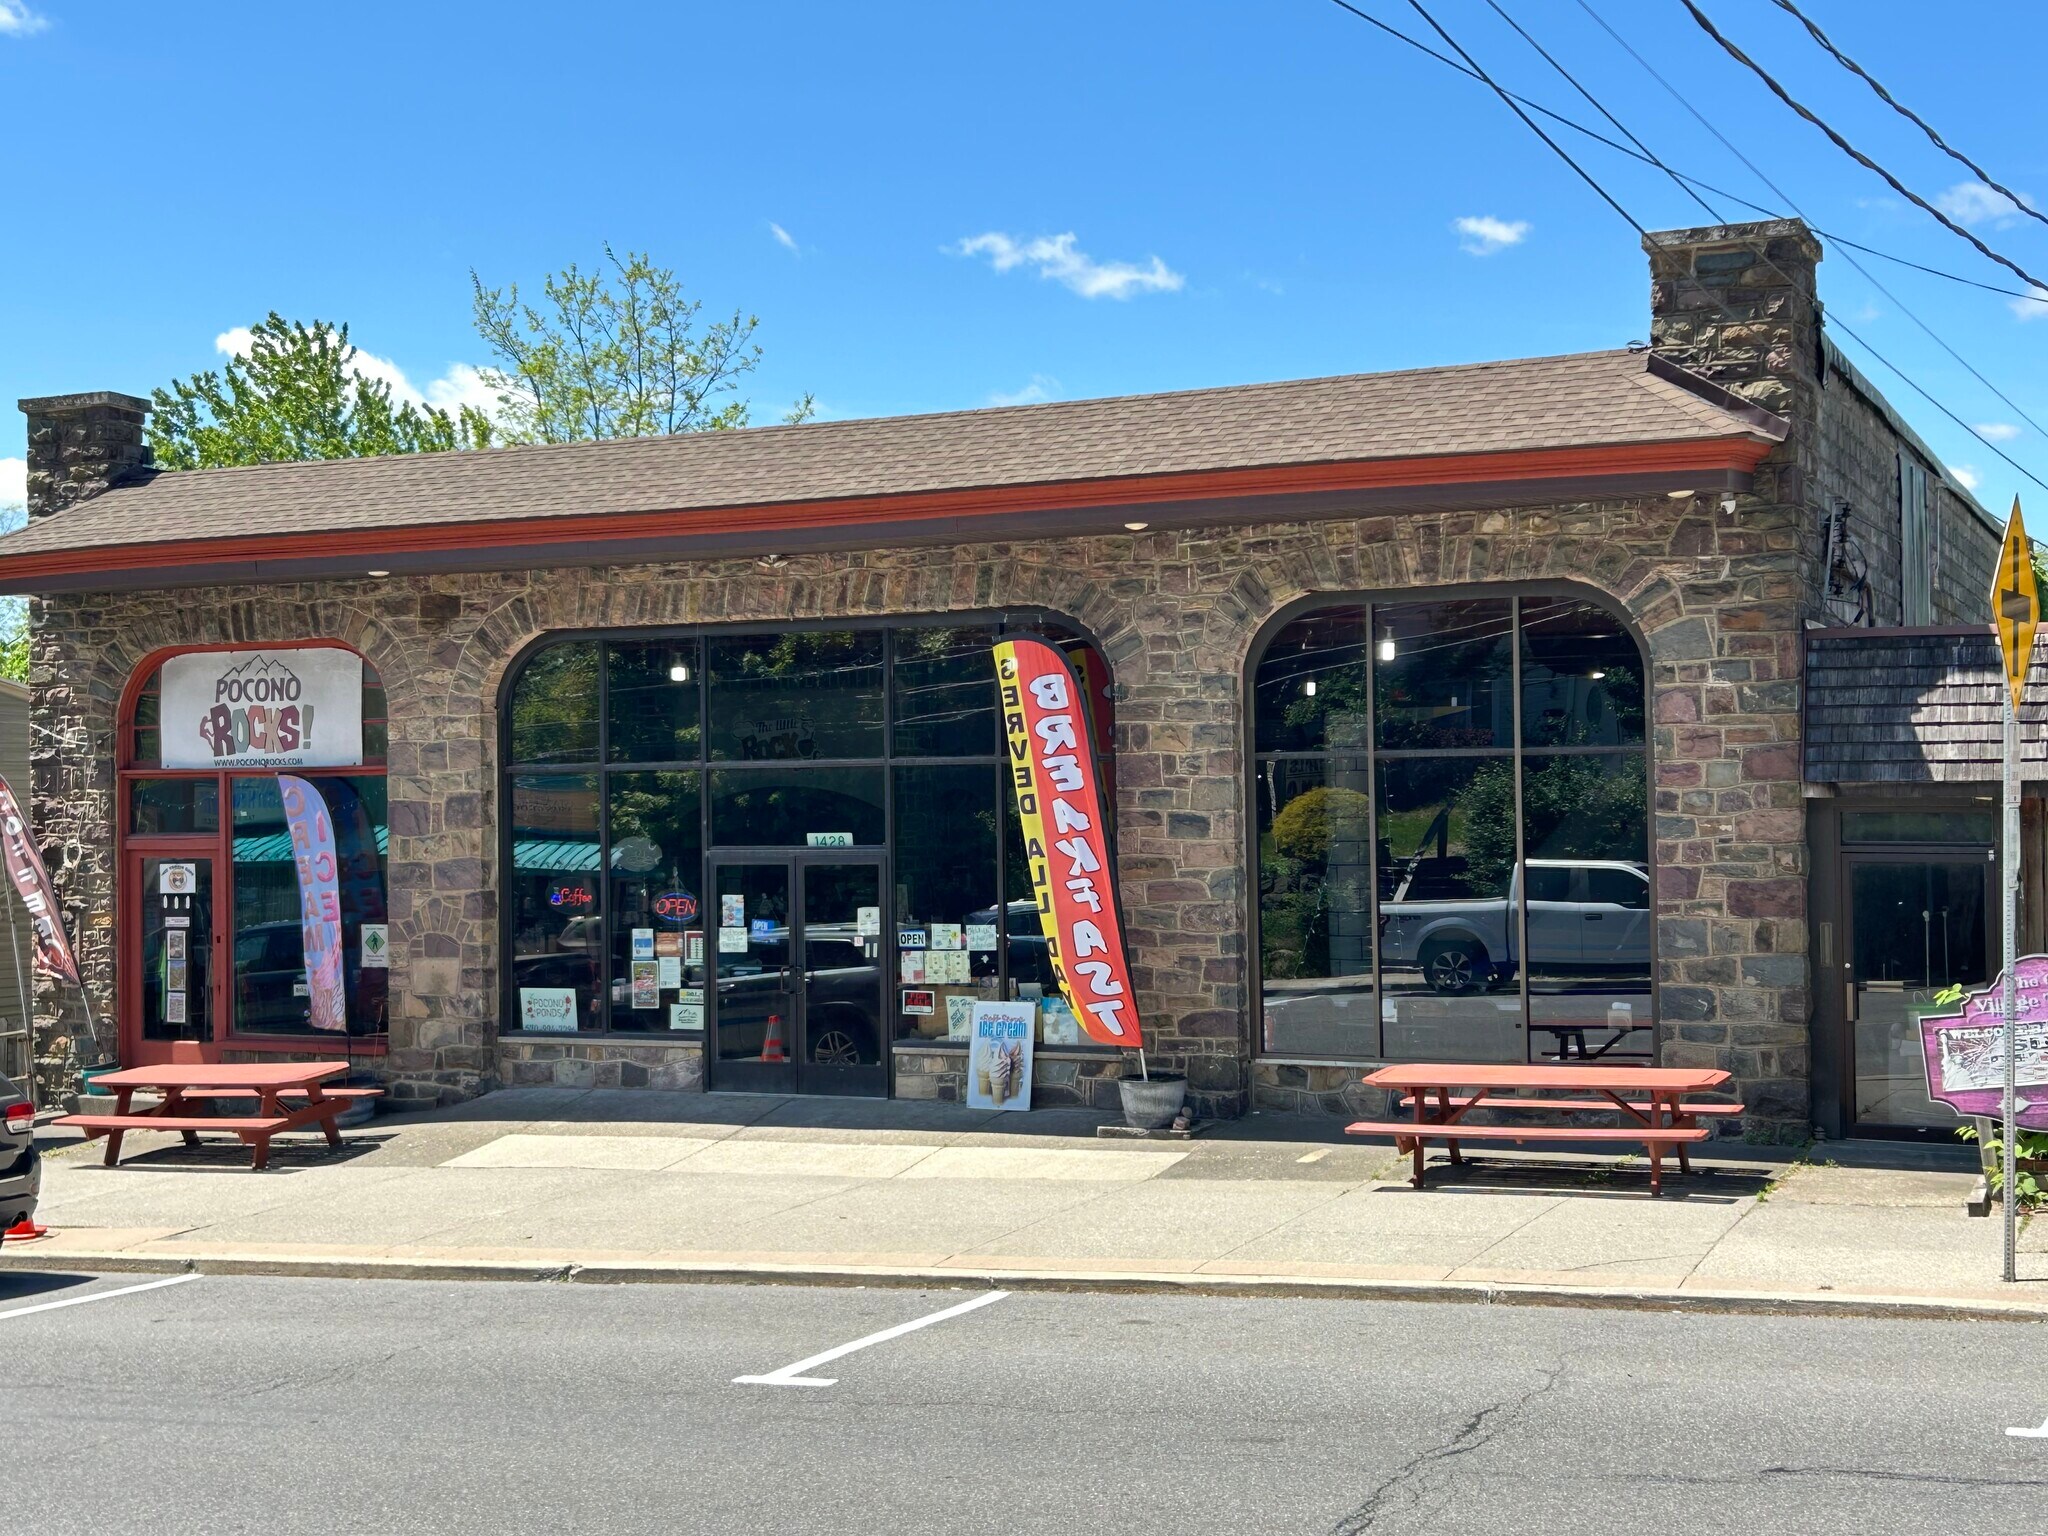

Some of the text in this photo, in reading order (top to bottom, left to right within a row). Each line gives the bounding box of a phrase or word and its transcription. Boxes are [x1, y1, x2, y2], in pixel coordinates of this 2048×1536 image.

[215, 677, 302, 703] POCONO
[209, 703, 315, 757] ROCKS!
[213, 758, 304, 768] WWW.POCONOROCKS.COM
[814, 835, 846, 846] 1428
[561, 888, 593, 906] Coffee
[655, 898, 697, 915] OPEN
[753, 920, 768, 931] OPEN
[900, 933, 924, 945] OPEN
[533, 998, 564, 1008] POCONO
[1973, 995, 2040, 1014] Villge
